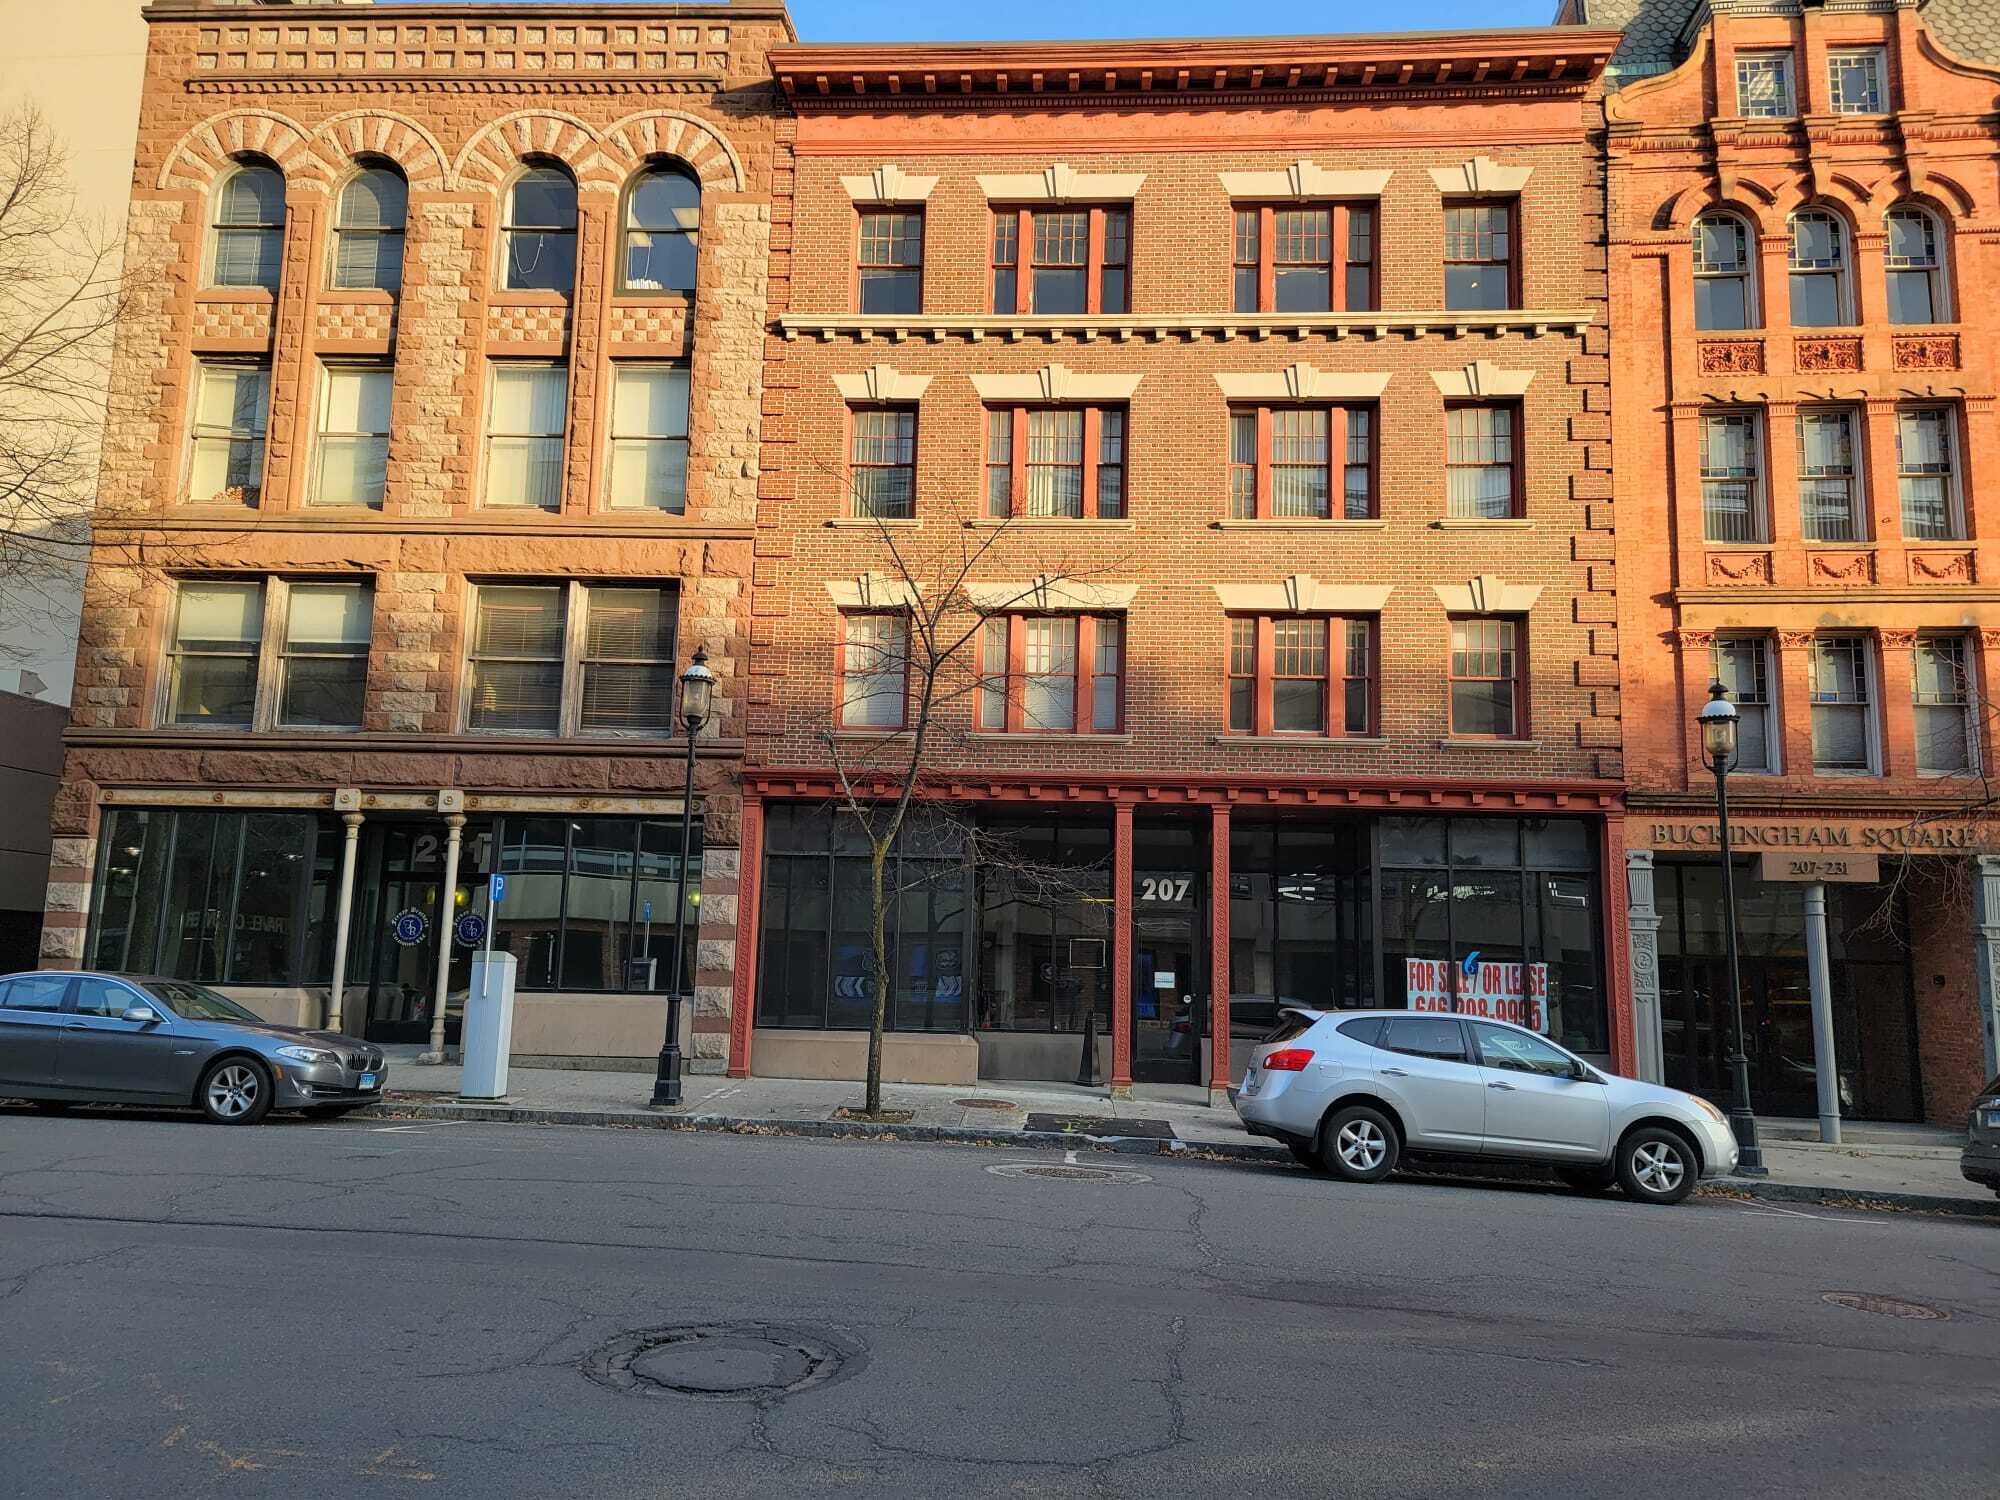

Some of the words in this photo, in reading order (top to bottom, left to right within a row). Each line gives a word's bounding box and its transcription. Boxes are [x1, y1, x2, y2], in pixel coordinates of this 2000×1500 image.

[1864, 827, 1979, 851] SQUARE
[1791, 861, 1848, 875] 207-231
[496, 877, 503, 898] P
[1141, 878, 1190, 901] 207
[1409, 962, 1434, 992] FOR
[1438, 962, 1470, 993] SLE
[1482, 964, 1501, 994] OR
[1415, 996, 1542, 1032] 6608-9995
